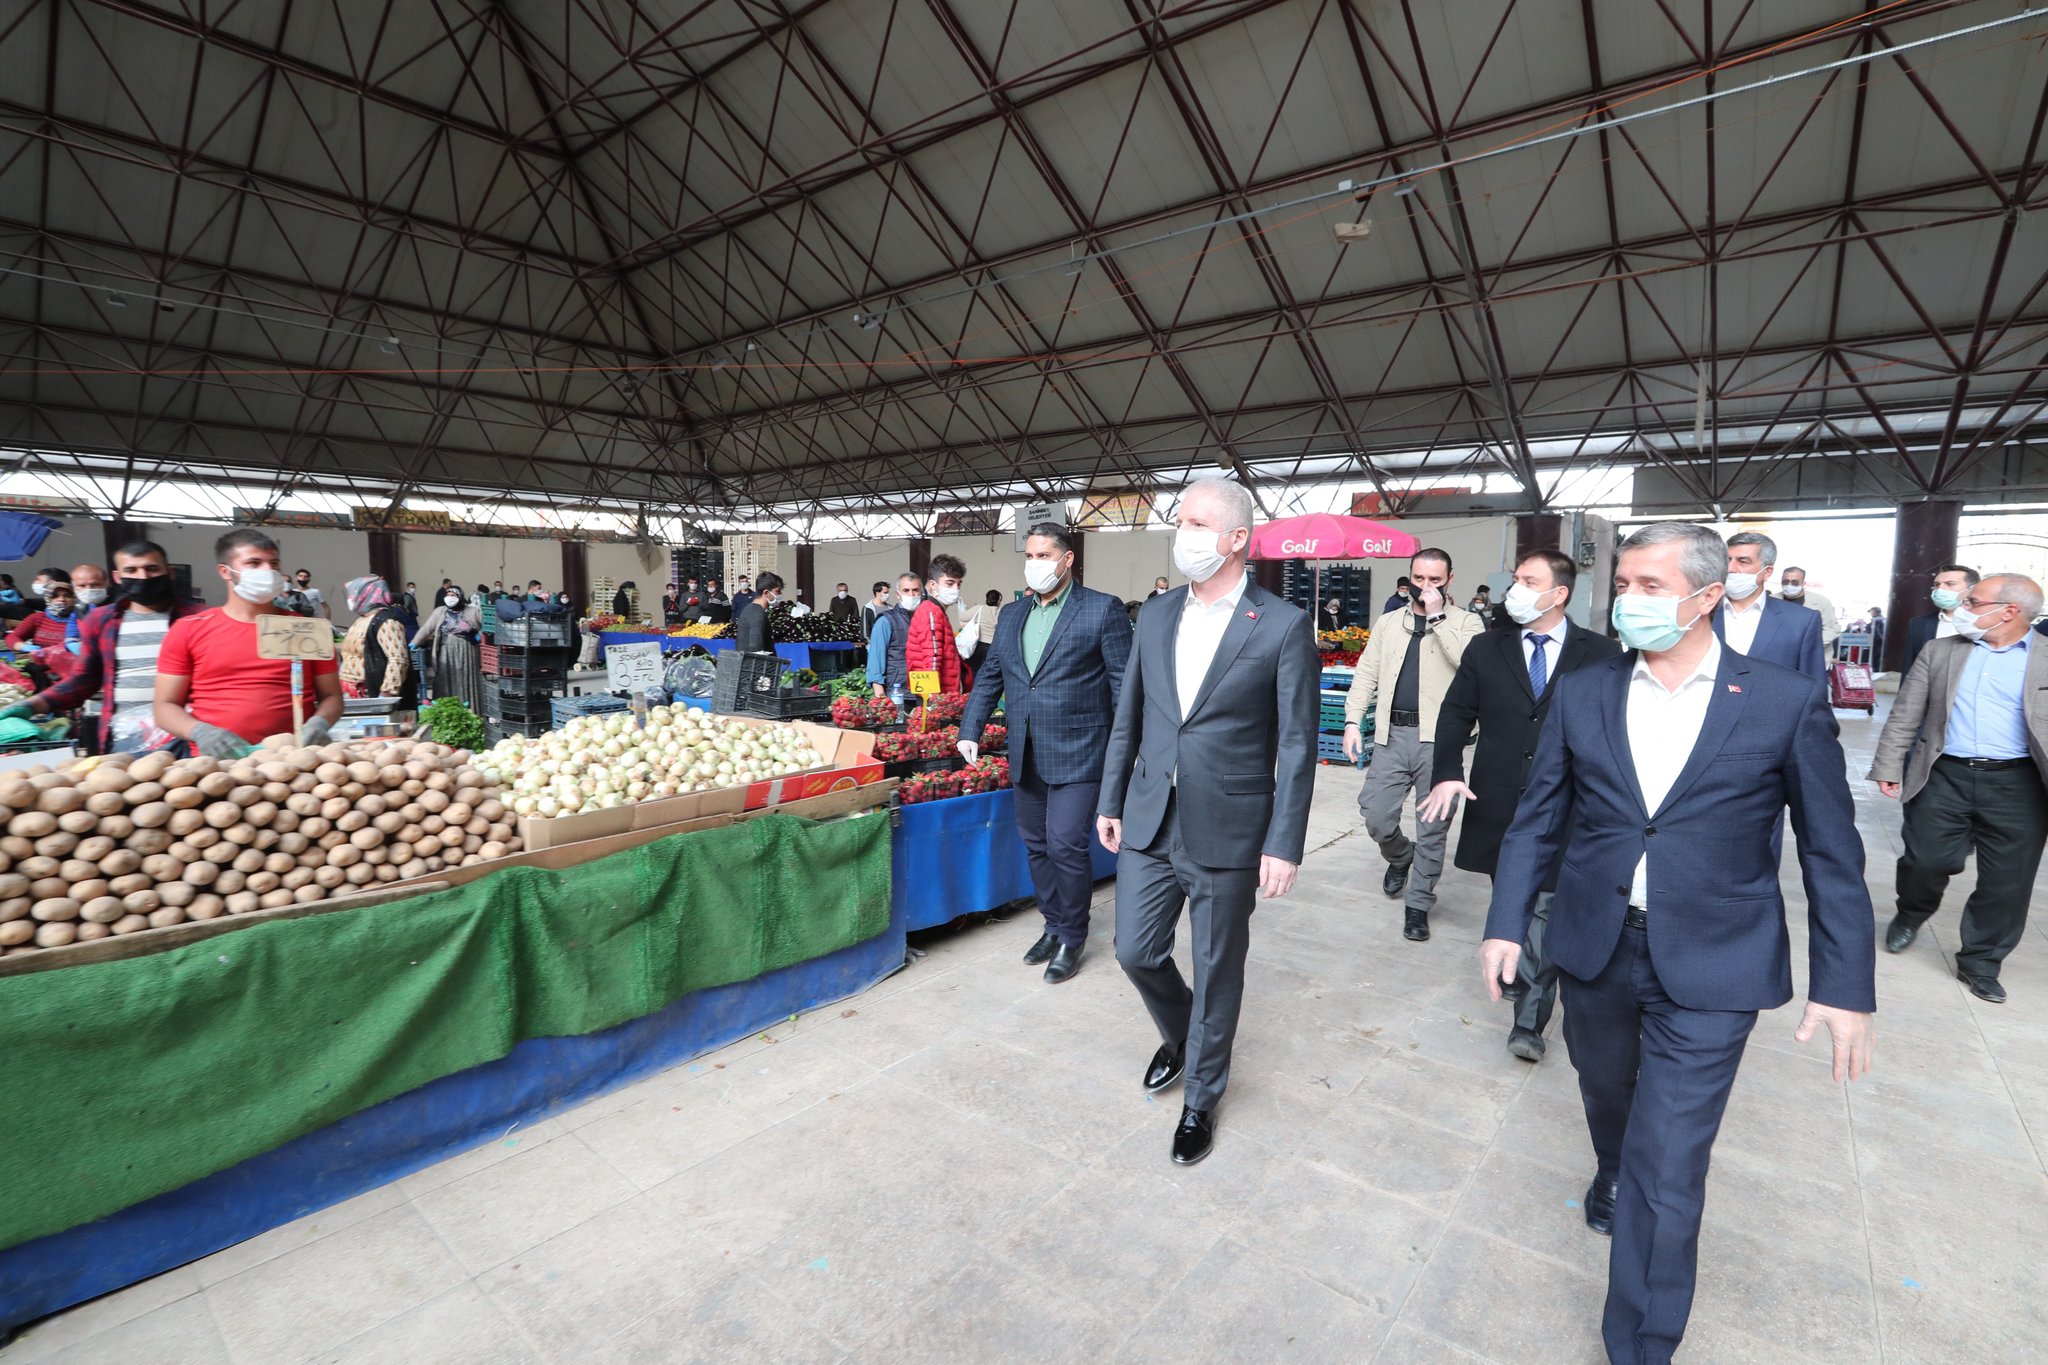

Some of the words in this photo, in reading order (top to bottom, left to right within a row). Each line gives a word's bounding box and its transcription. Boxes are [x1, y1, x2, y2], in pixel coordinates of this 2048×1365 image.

[1281, 539, 1319, 554] Golf
[1362, 539, 1393, 554] Golf
[915, 681, 924, 692] 6
